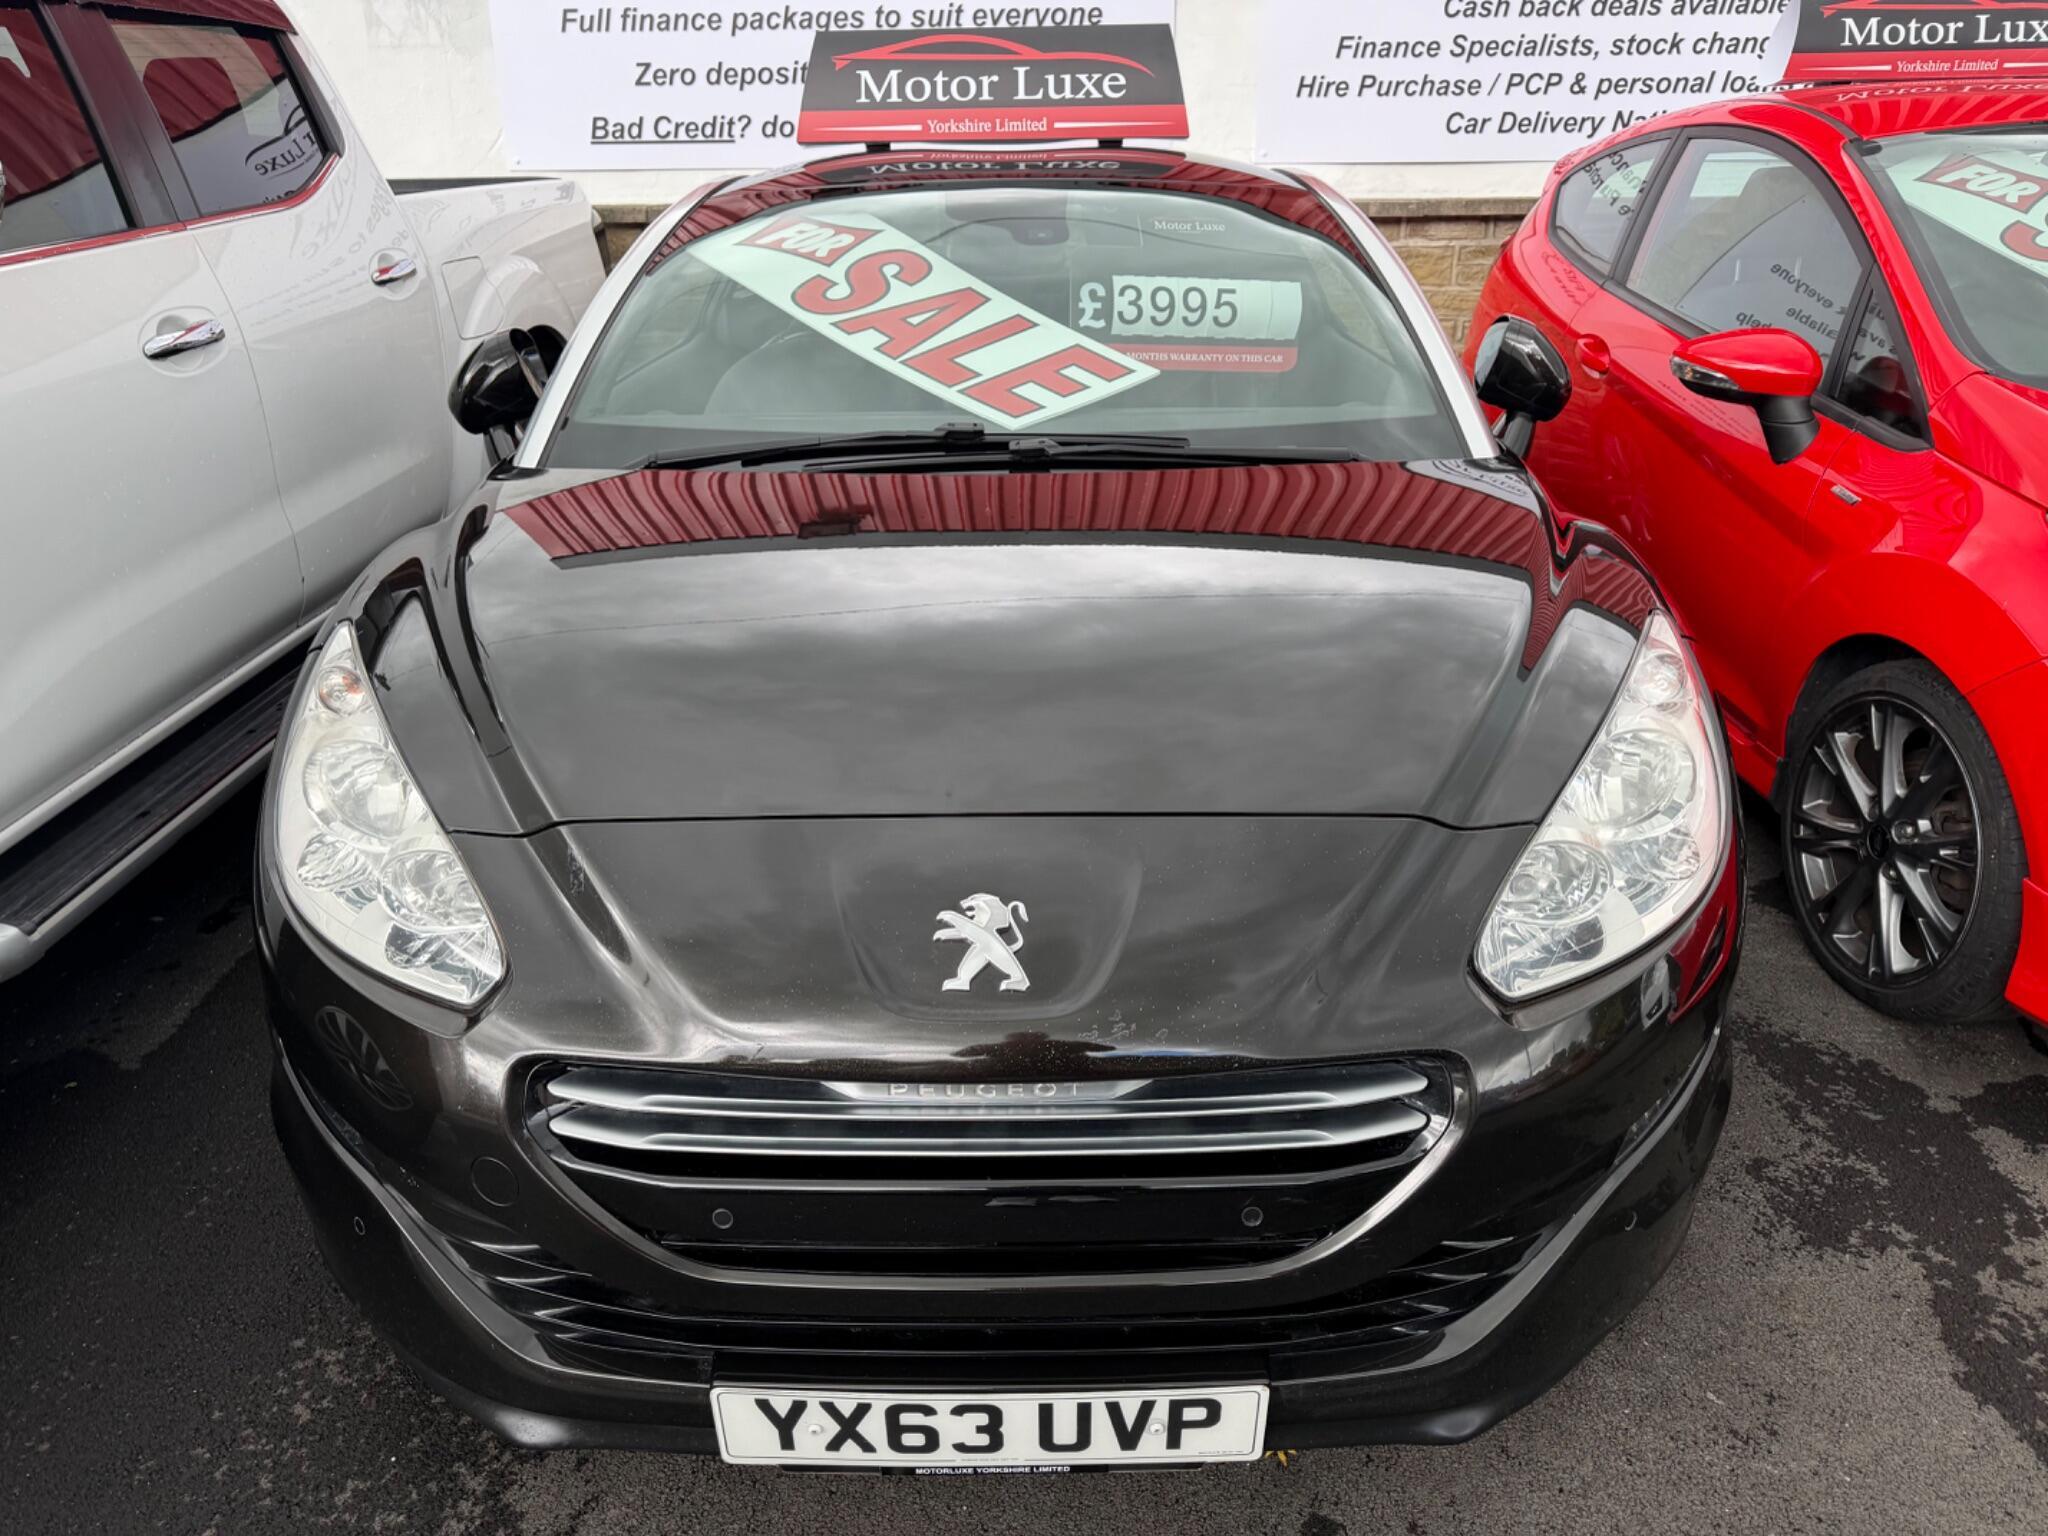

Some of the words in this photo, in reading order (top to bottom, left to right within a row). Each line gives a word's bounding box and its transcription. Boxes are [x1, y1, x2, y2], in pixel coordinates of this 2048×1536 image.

[561, 8, 611, 33] Full
[621, 7, 722, 32] finance
[731, 5, 864, 37] packages
[875, 5, 901, 28] to
[910, 3, 965, 27] suit
[972, 6, 1103, 27] everyone
[1444, 0, 1510, 18] Cash
[1519, 0, 1581, 17] back
[1591, 0, 1661, 16] deals
[1840, 16, 1964, 46] Motor
[1336, 35, 1441, 59] Finance
[1450, 33, 1599, 63] Specialists,
[1610, 32, 1685, 56] stock
[635, 61, 697, 87] Zero
[706, 60, 808, 91] deposit
[1896, 60, 1950, 73] Yorkshire
[1953, 59, 1998, 72] Limited
[855, 68, 999, 103] Motor
[1013, 66, 1127, 101] Luxe
[1296, 74, 1350, 98] Hire
[1358, 73, 1481, 97] Purchase
[1487, 72, 1501, 96] /
[1504, 72, 1563, 96] PCP
[1569, 72, 1587, 96] &
[1594, 70, 1715, 100] personal
[590, 116, 643, 141] Bad
[653, 114, 751, 140] Credit?
[927, 118, 992, 134] Yorkshire
[995, 117, 1047, 133] Limited
[1446, 112, 1491, 134] Car
[1497, 110, 1605, 138] Delivery
[1936, 164, 2041, 204] FOR
[771, 220, 854, 260] FOR
[1154, 220, 1191, 232] Motor
[1195, 220, 1226, 232] Luxe
[1078, 281, 1238, 329] £3995
[791, 248, 1137, 418] SALE
[1169, 352, 1223, 363] WARRANTY
[1225, 353, 1240, 363] ON
[1241, 353, 1263, 363] THIS
[1264, 354, 1284, 364] CAR
[888, 1082, 1085, 1098] PEUGEOT
[754, 1398, 1005, 1455] YX63
[1037, 1397, 1222, 1453] UVP
[915, 1467, 974, 1475] MOTORLUXE
[976, 1466, 1031, 1474] YORKSHIRE
[1033, 1465, 1071, 1473] LIMITED
